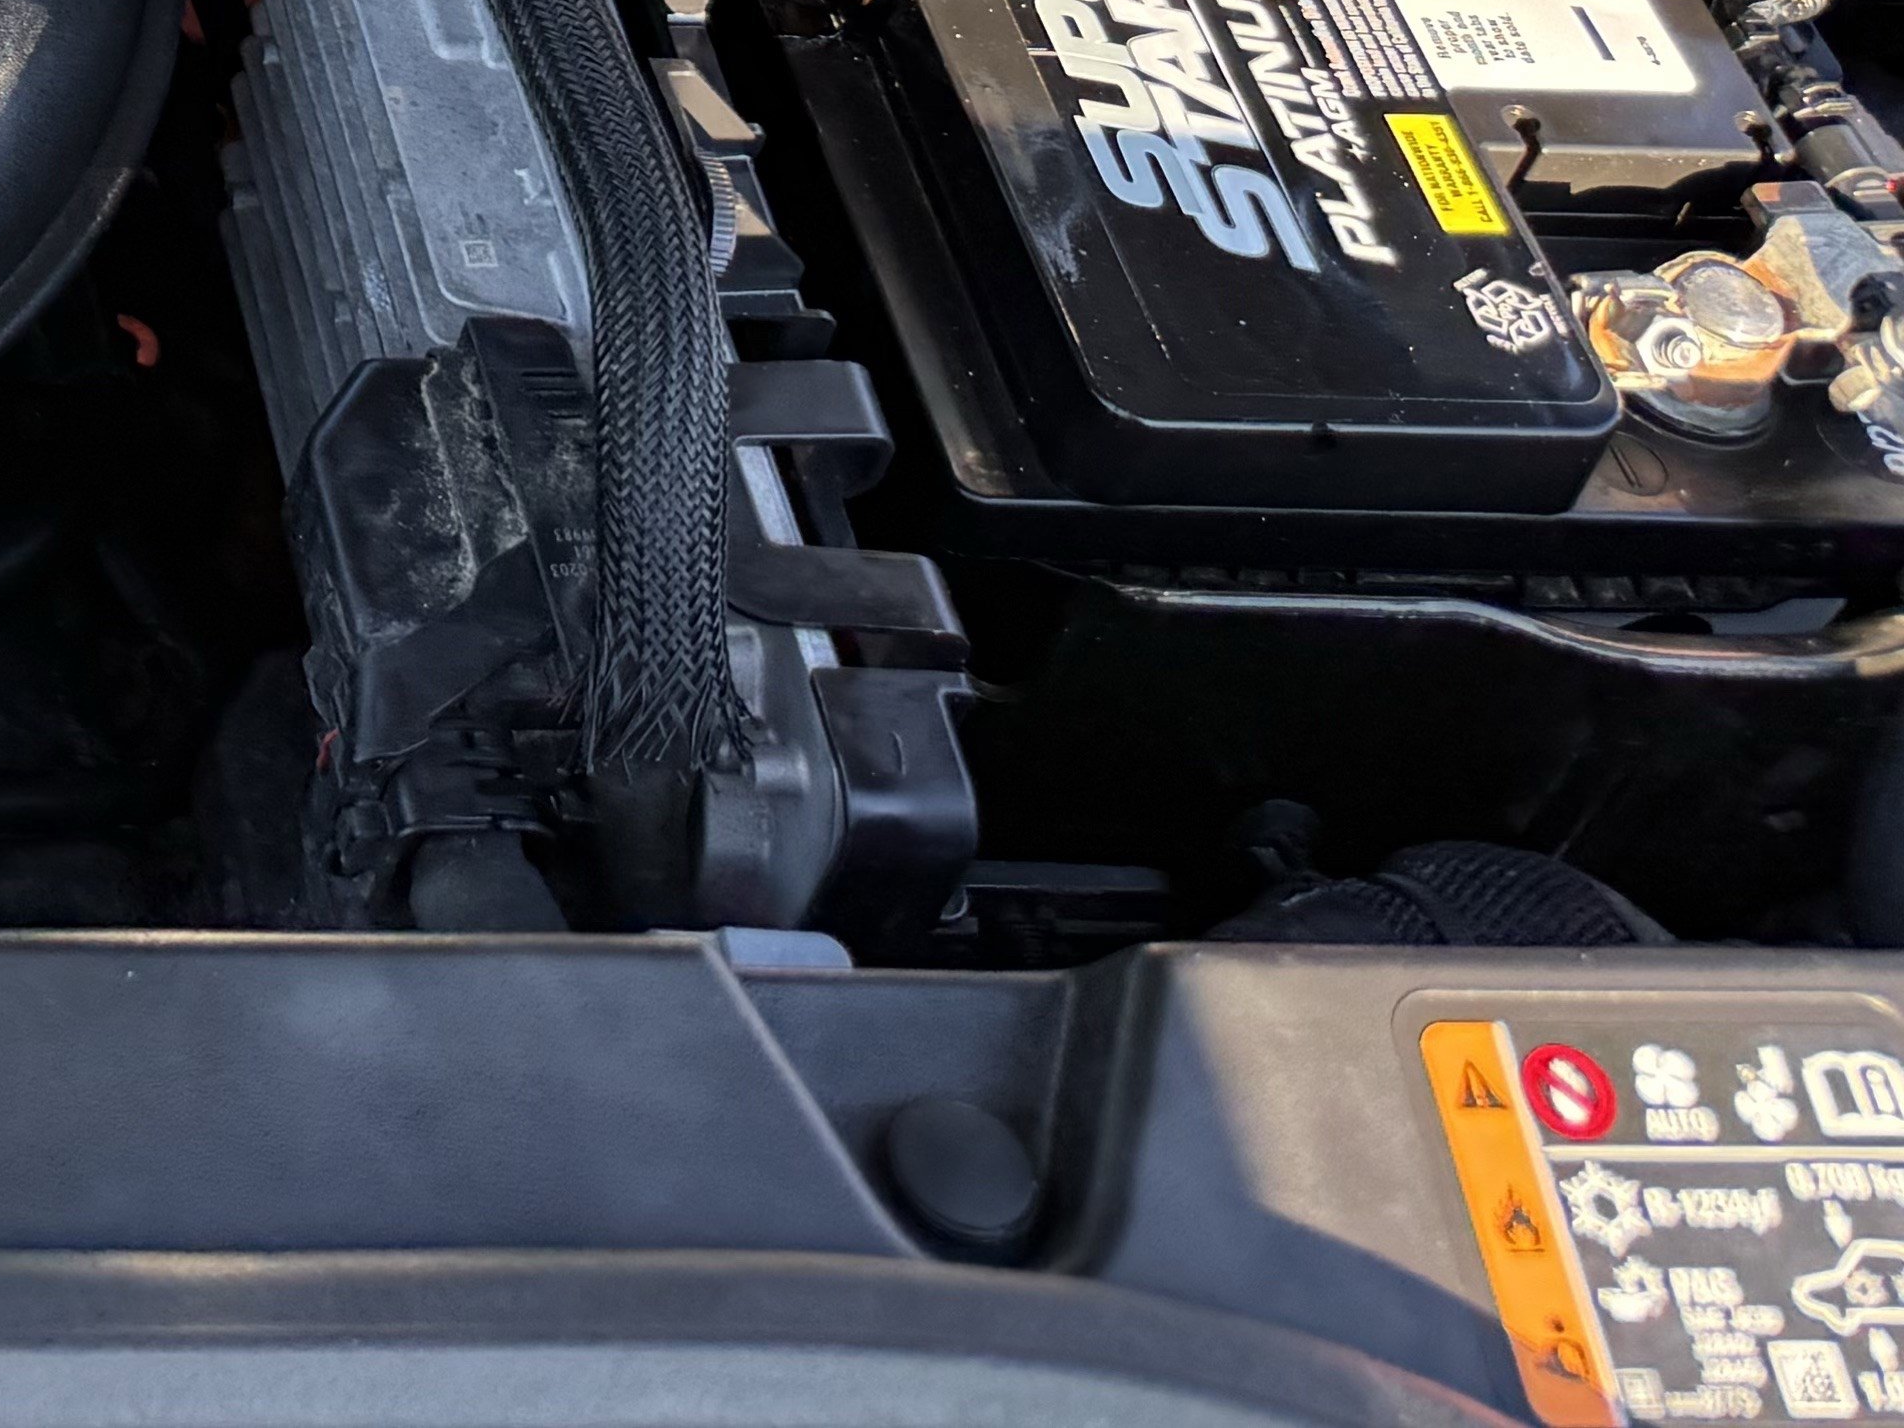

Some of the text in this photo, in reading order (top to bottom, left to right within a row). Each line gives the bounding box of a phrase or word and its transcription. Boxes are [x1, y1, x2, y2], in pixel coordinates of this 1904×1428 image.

[1420, 16, 1451, 60] Remove
[1437, 19, 1467, 54] proper
[1487, 18, 1510, 46] show
[1513, 41, 1535, 64] date
[1400, 131, 1456, 212] FOR NATIONWIDE
[1426, 144, 1463, 198] WARRANTY
[1473, 200, 1494, 223] CALL
[1646, 1107, 1720, 1142] AUTO
